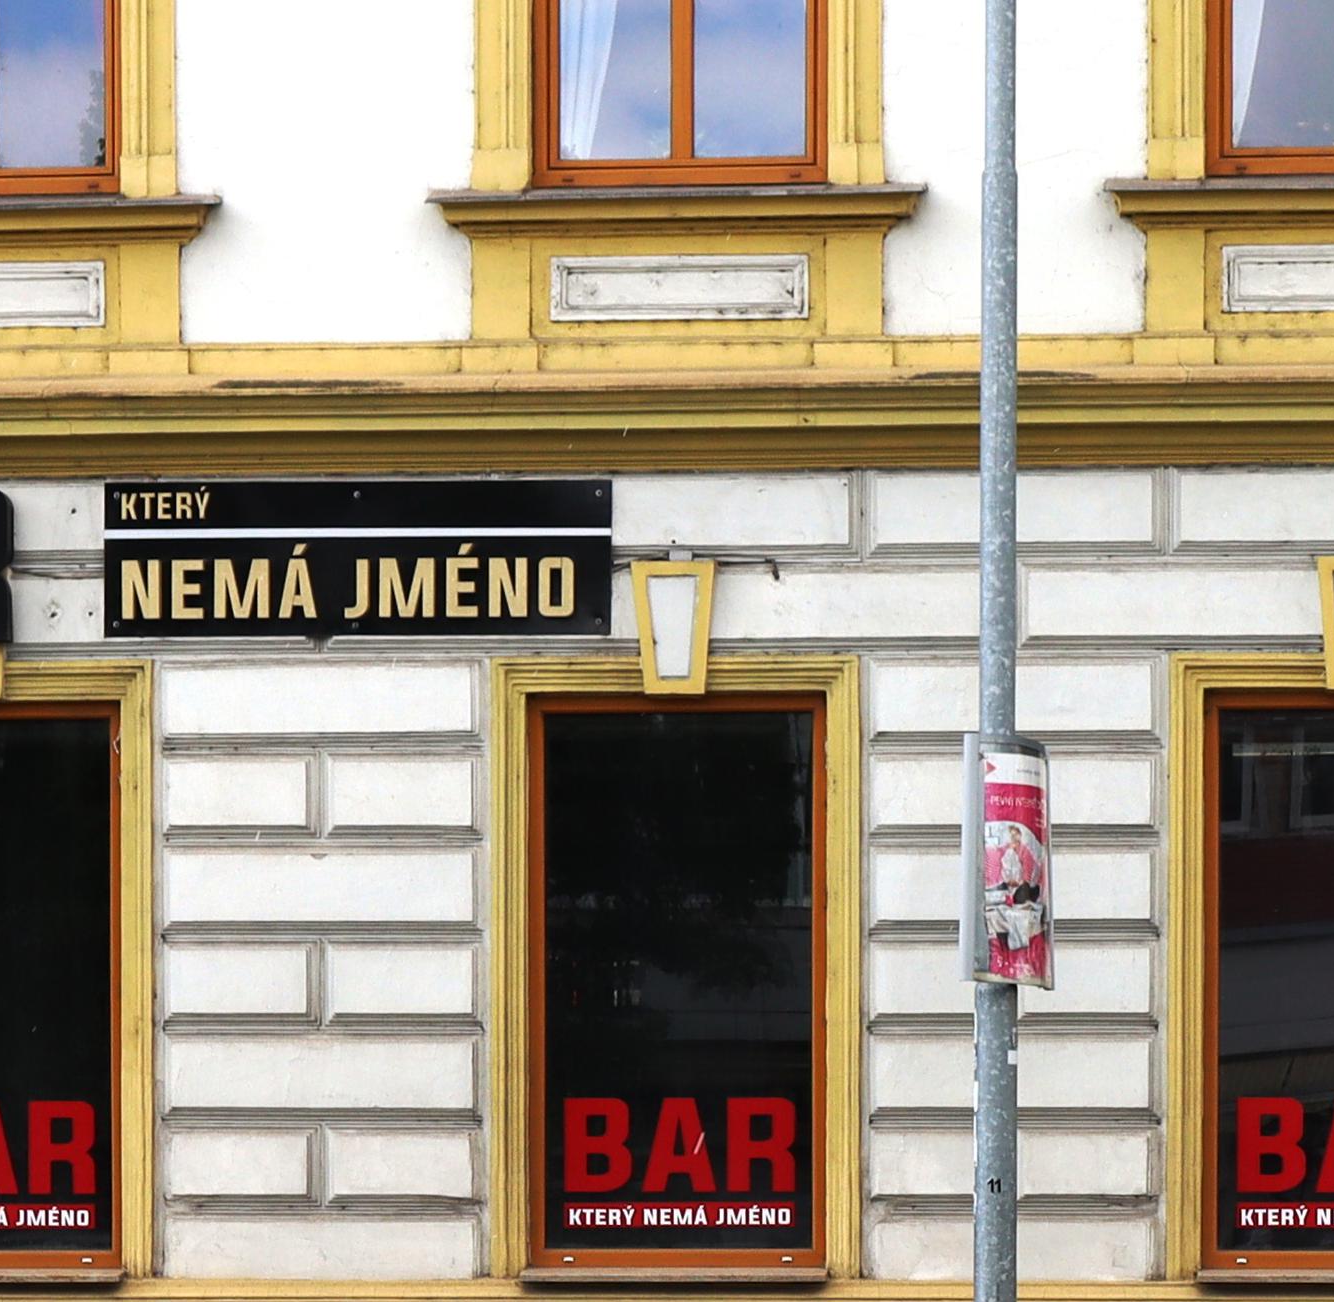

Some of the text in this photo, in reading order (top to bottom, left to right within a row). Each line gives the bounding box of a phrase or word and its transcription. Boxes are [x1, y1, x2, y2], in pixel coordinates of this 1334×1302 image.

[120, 486, 210, 520] KTERÝ
[121, 544, 575, 620] NEMÁ JMÉNO
[564, 1098, 795, 1192] BAR
[987, 1178, 1002, 1194] 11
[16, 1206, 89, 1227] JMÉNO
[569, 1205, 791, 1226] KTERÝ NEMÁ JMÉNO
[1241, 1205, 1308, 1226] KTERÝ
